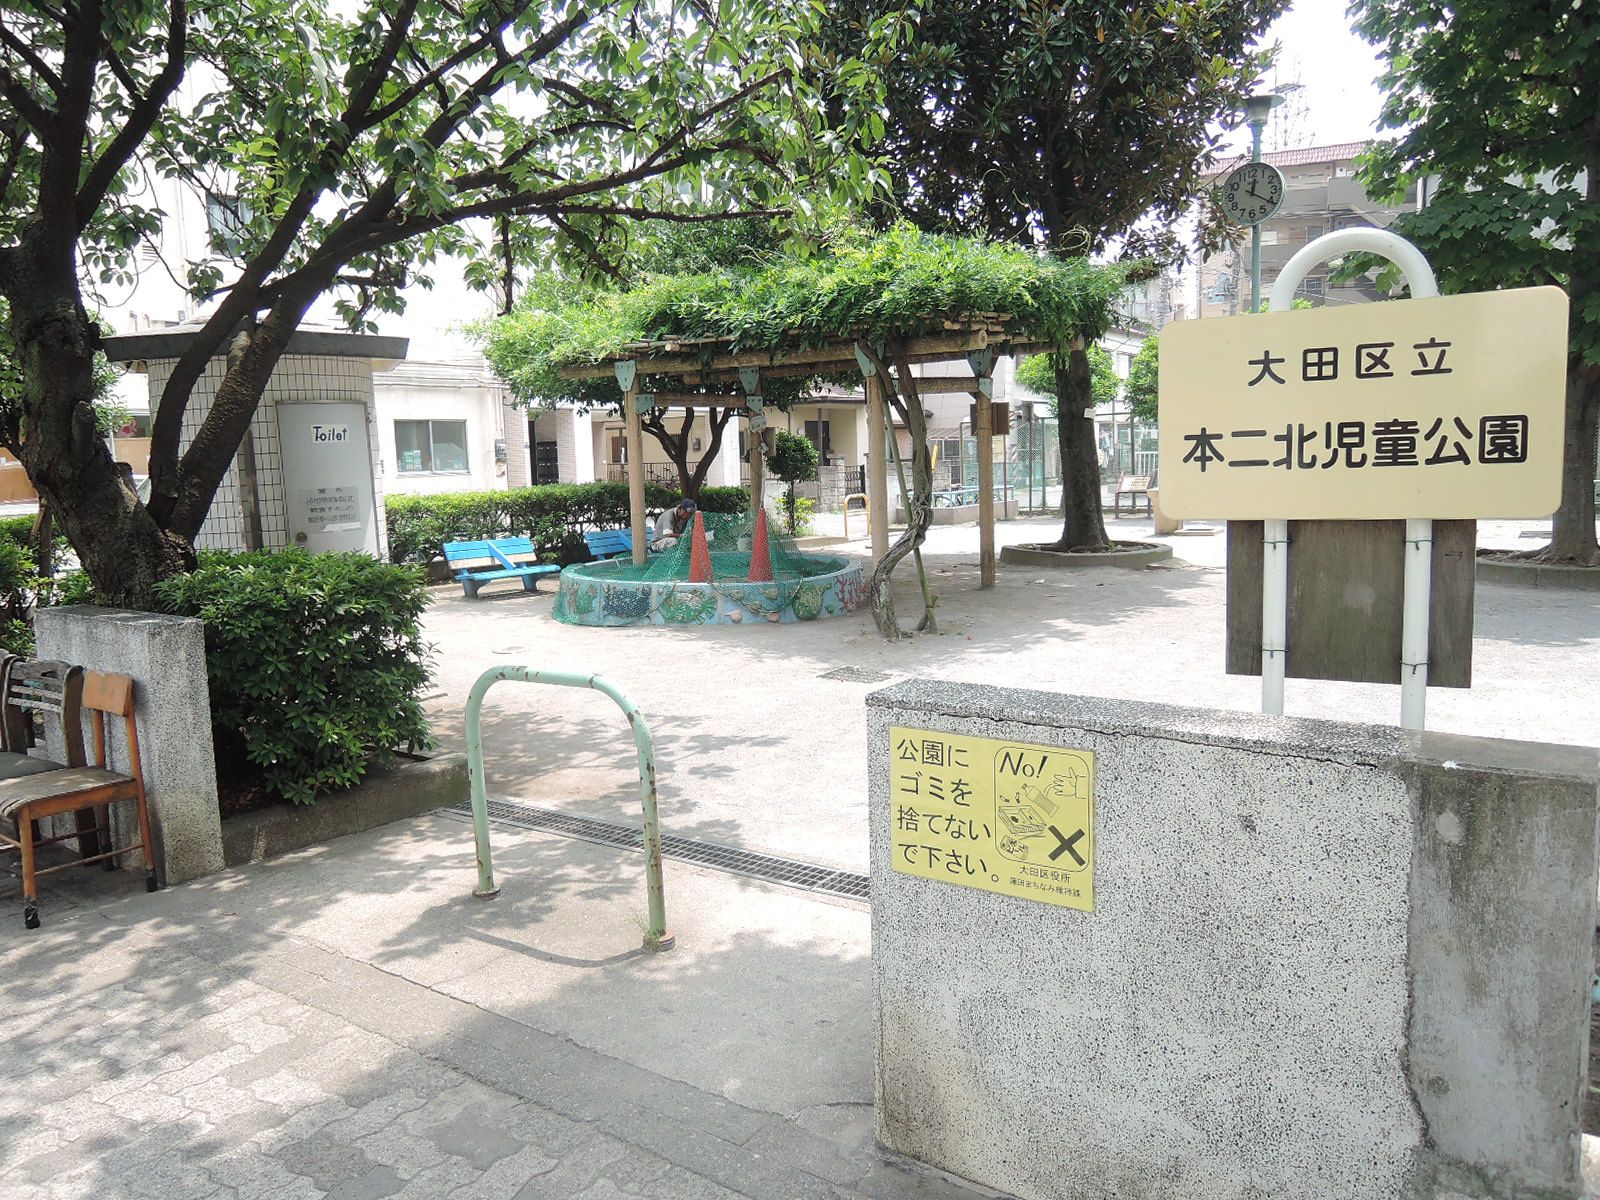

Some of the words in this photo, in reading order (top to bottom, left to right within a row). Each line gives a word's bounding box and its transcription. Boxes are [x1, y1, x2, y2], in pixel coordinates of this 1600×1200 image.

[1238, 172, 1247, 182] 11
[1247, 169, 1258, 179] 12
[1268, 175, 1275, 184] 2
[1271, 185, 1278, 194] 3
[1227, 193, 1235, 202] 9
[1268, 195, 1275, 204] 4
[1231, 202, 1238, 211] 8
[1260, 205, 1267, 214] 5
[1240, 209, 1246, 217] 7
[1248, 209, 1256, 218] 6
[1247, 336, 1453, 387] 大田区立
[313, 426, 347, 441] Toilet
[1182, 413, 1529, 472] 本二北児童公園
[896, 738, 970, 768] 公園に
[999, 751, 1049, 779] No!
[900, 771, 973, 807] ゴミを
[897, 804, 992, 840] 捨てない
[897, 842, 1000, 883] で下さい。
[1019, 865, 1071, 884] 大田区役所
